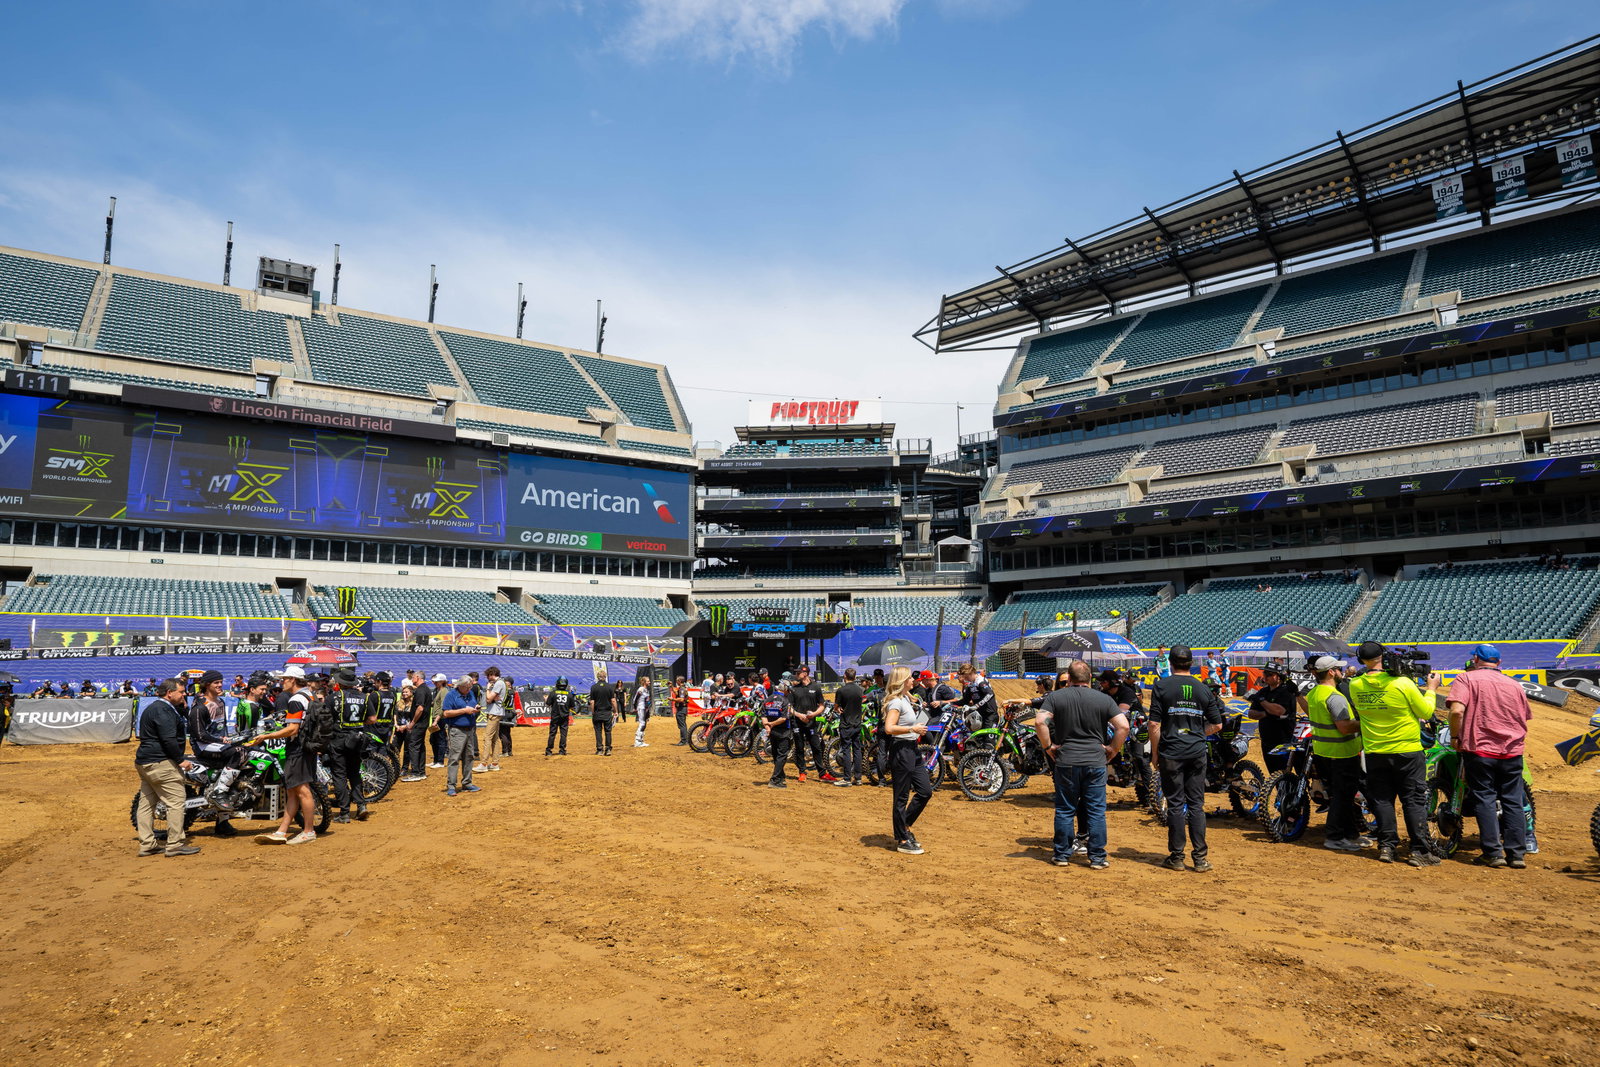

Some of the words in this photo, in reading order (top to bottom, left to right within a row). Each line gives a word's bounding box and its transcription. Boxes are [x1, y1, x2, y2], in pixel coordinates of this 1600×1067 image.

[1562, 146, 1588, 160] 1949
[1496, 167, 1522, 179] 1948
[1562, 160, 1593, 174] CHAMPIONS
[1436, 184, 1460, 197] 1947
[1496, 180, 1526, 192] CHAMPIONS
[1438, 201, 1464, 211] CHAMPIONS
[16, 372, 59, 392] 1:11
[232, 401, 287, 419] Lincoln
[292, 409, 356, 427] Financial
[360, 418, 392, 431] Field
[45, 456, 111, 478] SMX
[67, 476, 112, 484] CHAMPIONSHIP
[520, 482, 640, 515] American
[520, 530, 543, 543] GO
[546, 532, 588, 546] BIRDS
[626, 539, 667, 551] verizon
[750, 608, 789, 617] MONSTER
[318, 620, 367, 636] SMX
[556, 694, 567, 703] 33
[350, 704, 360, 721] 2
[383, 703, 390, 718] 7
[16, 711, 105, 725] TRIUMPH
